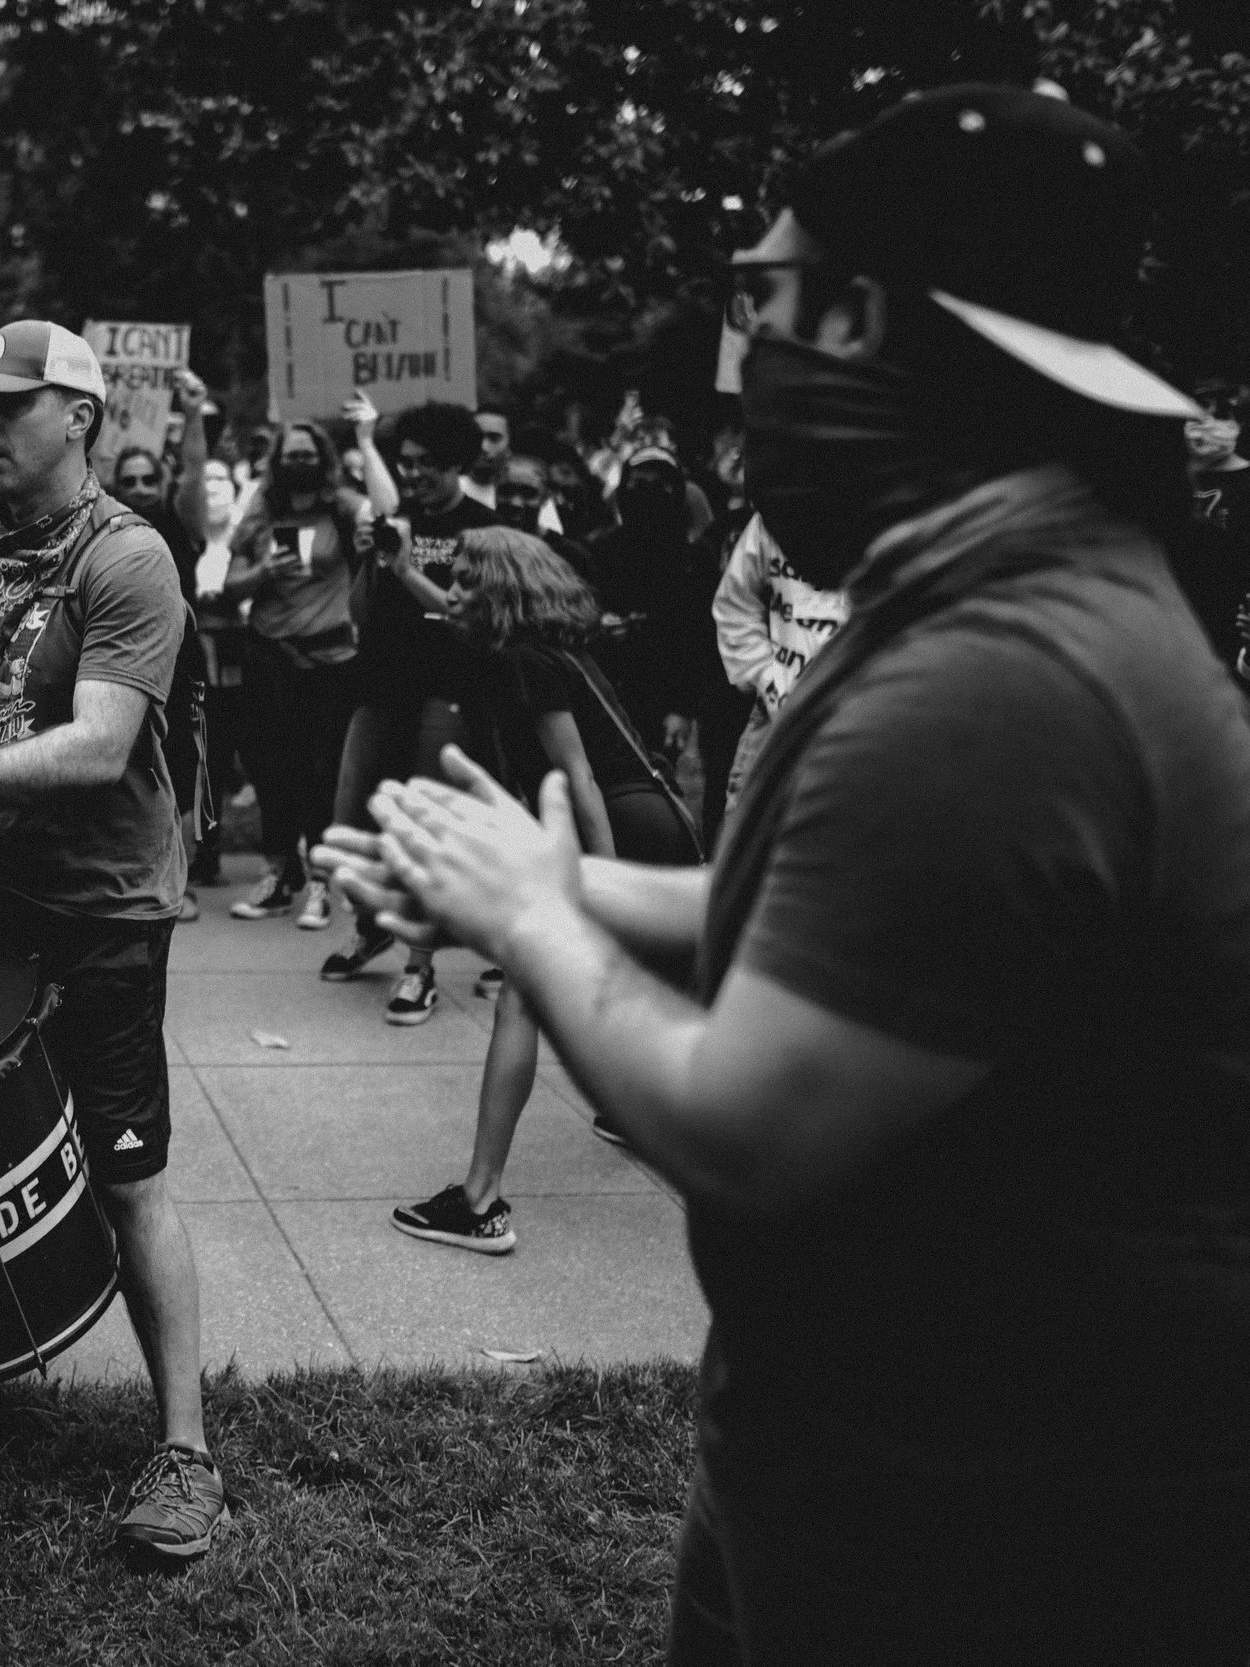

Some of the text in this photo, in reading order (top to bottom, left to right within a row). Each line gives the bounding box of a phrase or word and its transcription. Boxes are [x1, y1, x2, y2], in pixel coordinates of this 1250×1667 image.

[319, 278, 349, 325] I
[106, 326, 118, 357] I
[113, 1139, 144, 1151] adidas
